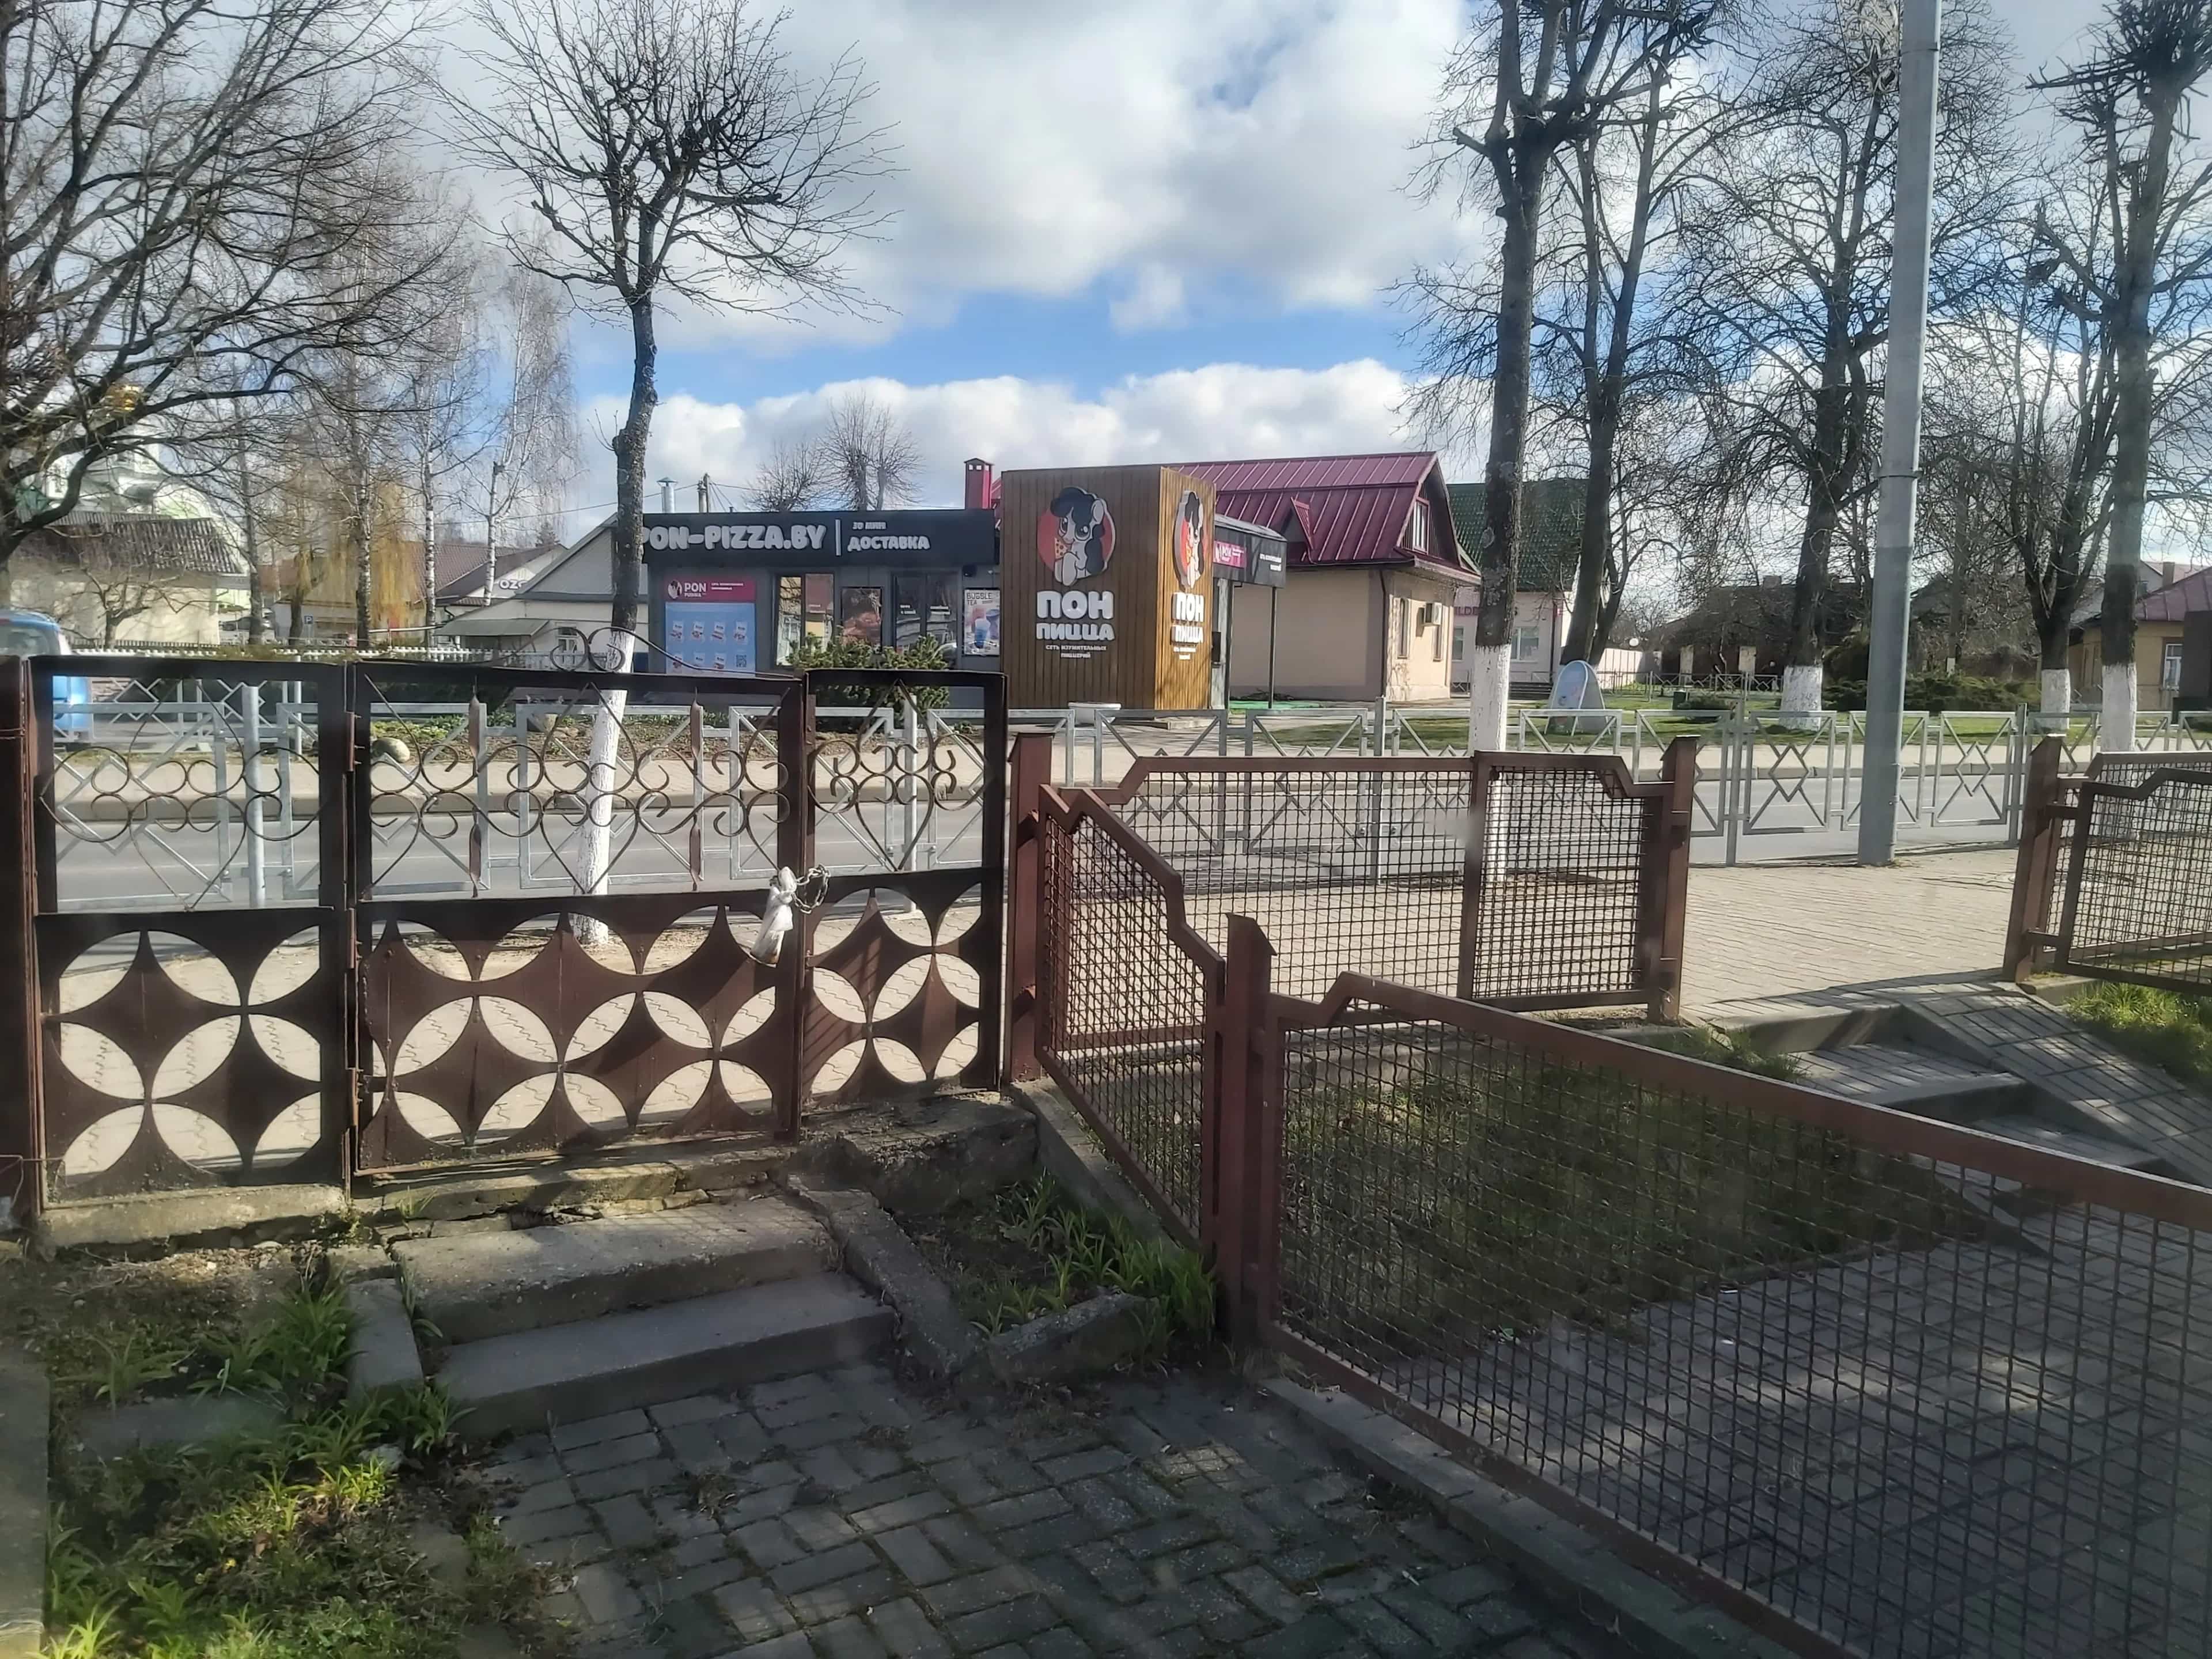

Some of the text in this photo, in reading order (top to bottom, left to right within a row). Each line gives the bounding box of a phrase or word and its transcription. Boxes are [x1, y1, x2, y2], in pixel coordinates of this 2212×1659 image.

[847, 536, 930, 551] ДОСТАВКА
[684, 582, 706, 592] PON
[1037, 590, 1114, 619] ПОН
[1175, 593, 1204, 622] ПОН
[1036, 623, 1115, 641] ПИЦЦА
